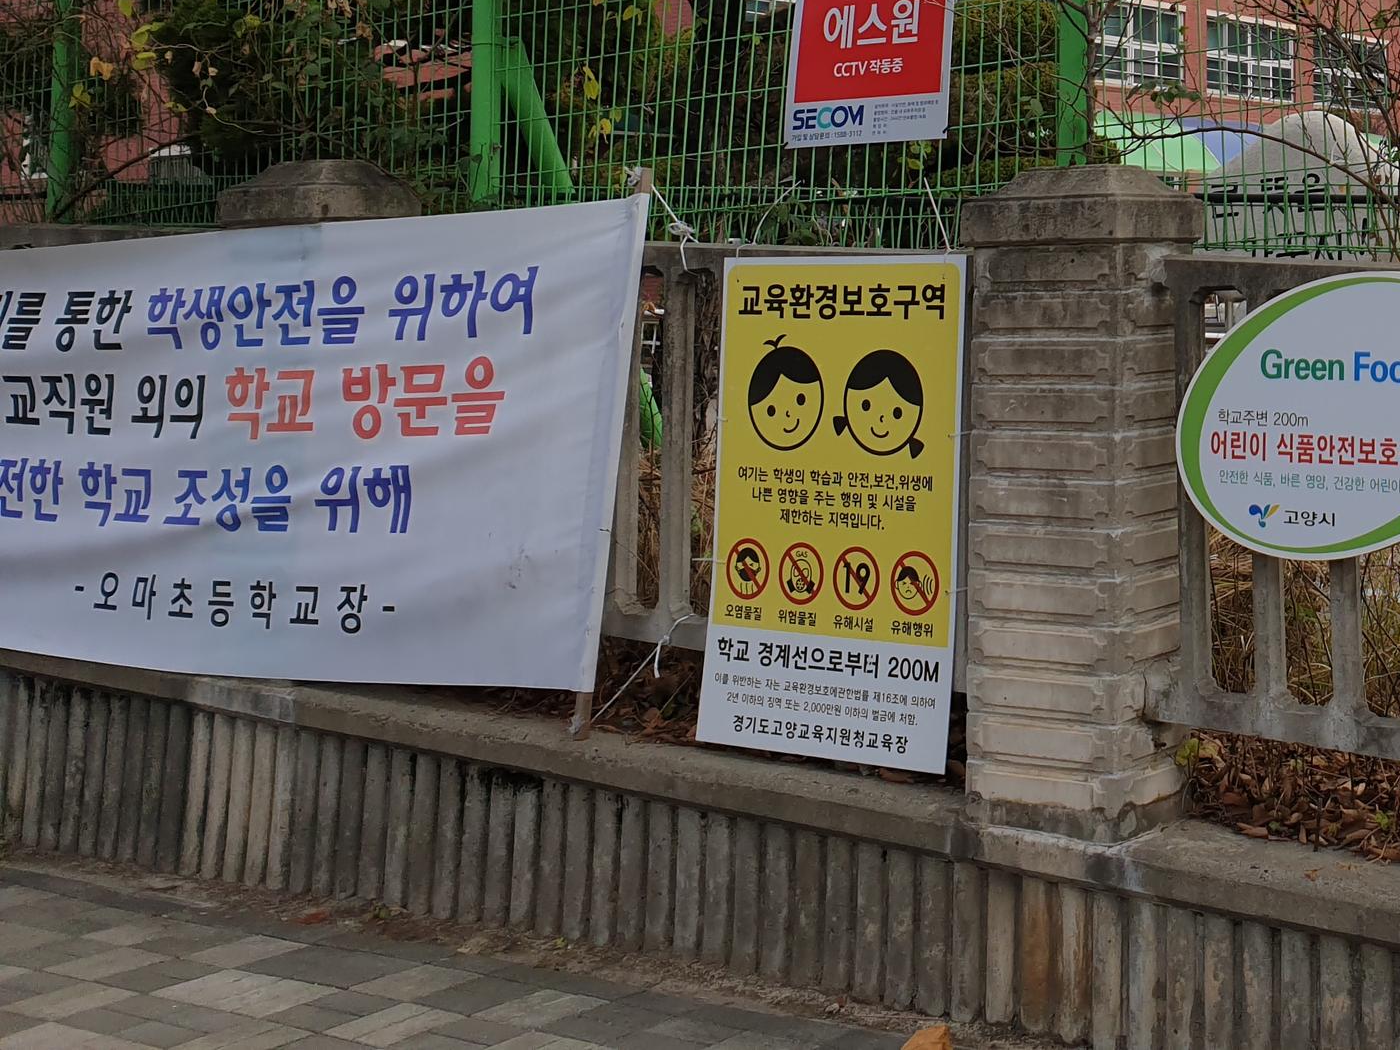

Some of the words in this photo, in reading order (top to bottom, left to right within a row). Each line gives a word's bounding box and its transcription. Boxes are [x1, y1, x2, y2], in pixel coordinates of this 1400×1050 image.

[834, 61, 868, 77] CCTV
[869, 57, 903, 75] 작동중
[792, 105, 865, 131] SECOM
[55, 290, 133, 352] 통한
[146, 276, 365, 351] 학생안전을
[388, 265, 539, 341] 위하여
[738, 283, 946, 320] 교육환경보호구역
[1260, 348, 1345, 381] Green
[2, 373, 115, 436] 교직원
[131, 374, 206, 438] 외의
[225, 367, 316, 439] 학교
[341, 355, 505, 439] 방문을
[1218, 409, 1268, 427] 학교주변
[1273, 412, 1309, 427] 200m
[1211, 430, 1267, 461] 어린이
[738, 466, 768, 482] 여기는
[773, 468, 805, 484] 학생의
[810, 469, 843, 486] 학습과
[848, 472, 933, 492] 안전,보건,위생에
[1219, 470, 1248, 485] 안전한
[1253, 471, 1276, 487] 식품,
[1280, 473, 1300, 488] 바른
[1305, 474, 1328, 490] 영양,
[1333, 476, 1365, 492] 건강한
[1370, 477, 1400, 493] 어린이
[0, 457, 63, 522] 전한
[78, 462, 152, 527] 학교
[164, 464, 292, 532] 조성을
[315, 464, 411, 534] 위해
[752, 487, 773, 503] 나쁜
[777, 488, 809, 505] 영향을
[814, 490, 836, 507] 주는
[840, 491, 862, 508] 행위
[867, 494, 878, 509] 및
[882, 495, 917, 512] 시설을
[779, 508, 824, 526] 제한하는
[828, 512, 885, 530] 지역입니다.
[1283, 510, 1336, 527] 고양시
[843, 562, 870, 595] 19
[724, 604, 762, 621] 오염물질
[778, 609, 817, 627] 위험물질
[833, 615, 874, 633] 유해시설
[891, 621, 934, 638] 유해행위
[717, 637, 750, 662] 학교
[758, 642, 880, 679] 경계선으로부터
[888, 657, 940, 683] 200M
[714, 672, 729, 685] 이를
[732, 675, 762, 689] 위반하는
[765, 678, 780, 691] 자는
[873, 691, 907, 706] 제16조에
[911, 696, 936, 709] 의하여
[726, 692, 739, 704] 2년
[742, 693, 764, 707] 이하의
[767, 696, 782, 709] 징역
[785, 698, 801, 711] 또는
[803, 701, 842, 716] 2,000만원
[845, 706, 868, 719] 이하의
[733, 714, 909, 754] 경기도고양교육지원청교육장
